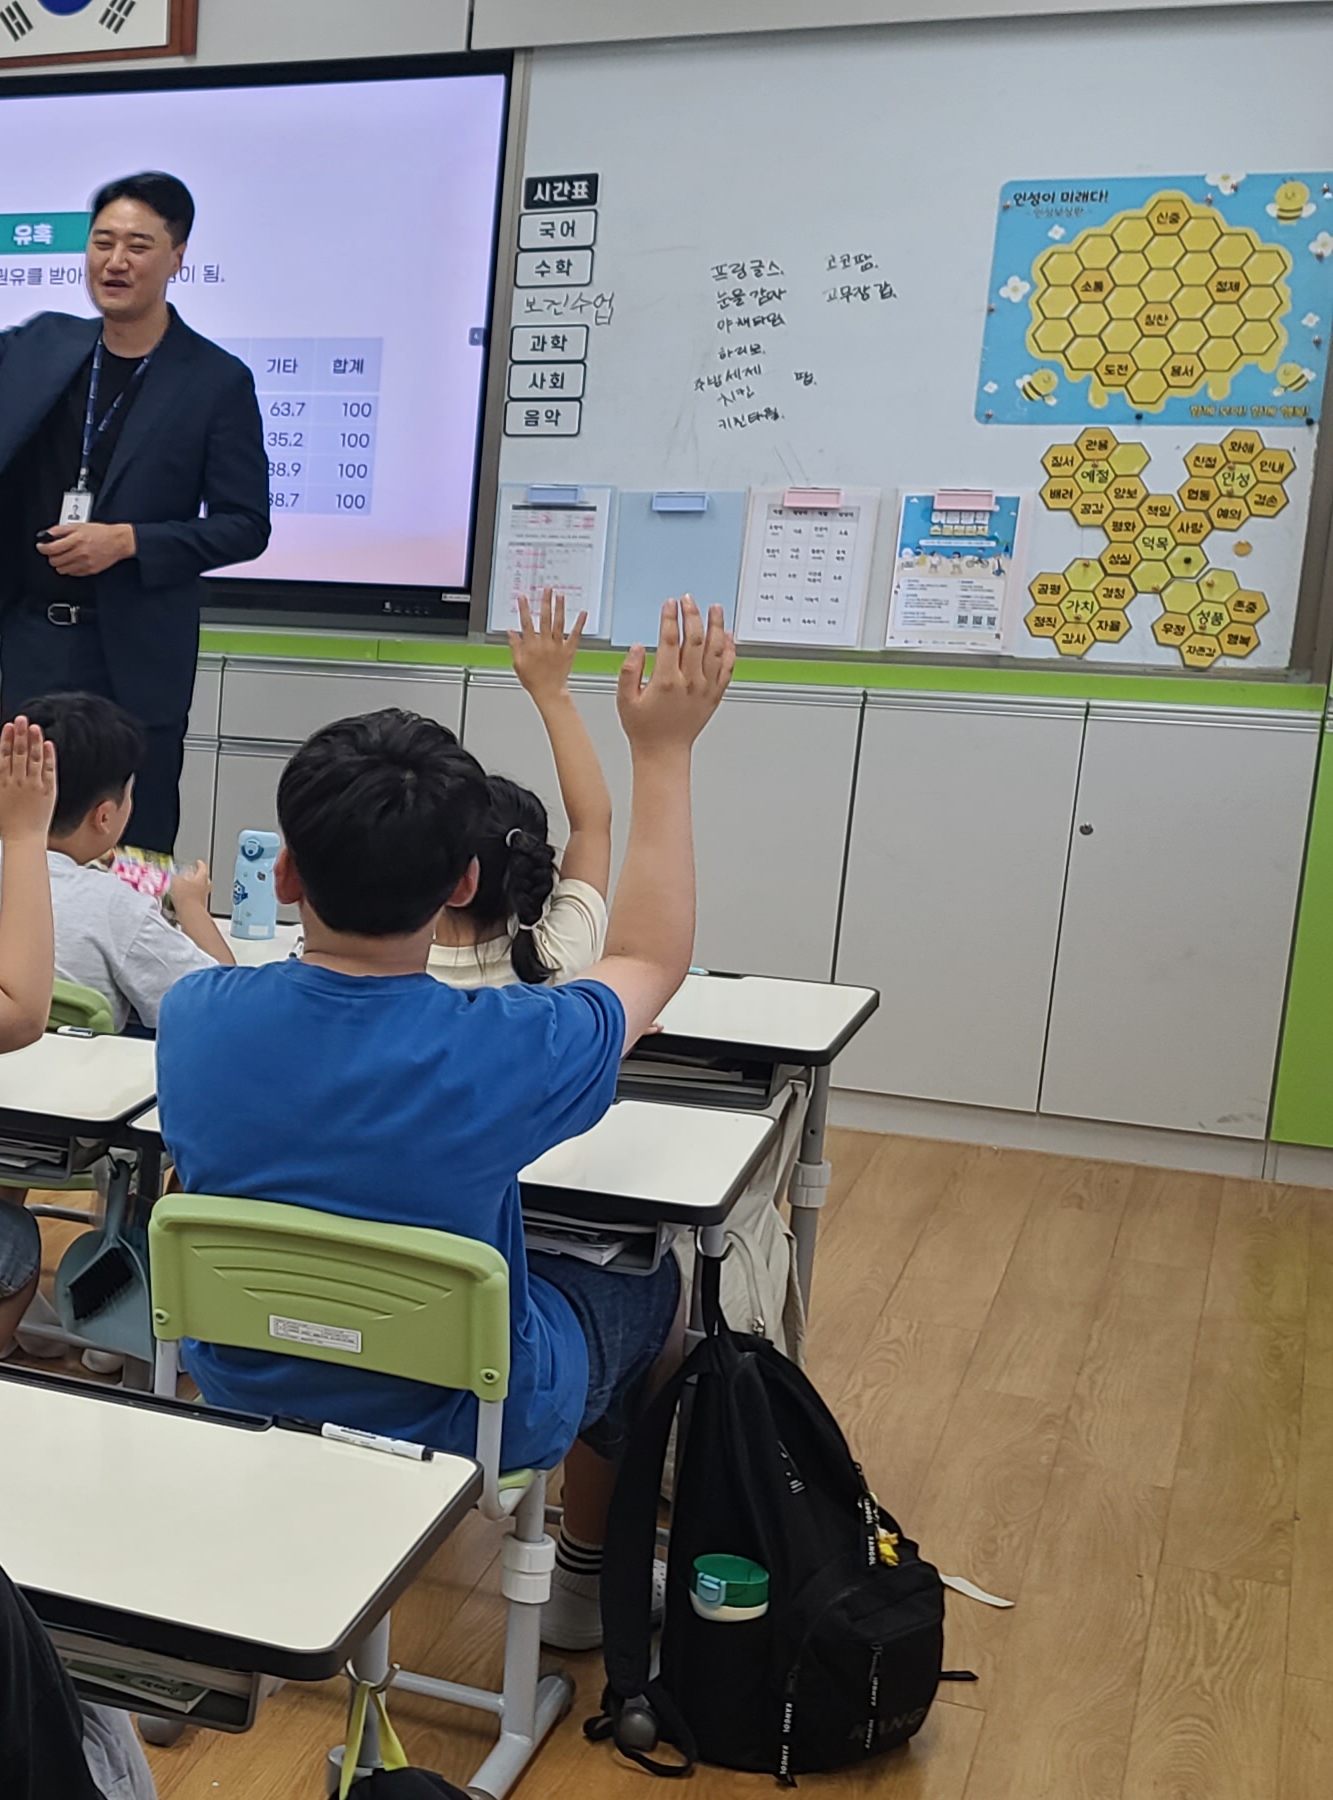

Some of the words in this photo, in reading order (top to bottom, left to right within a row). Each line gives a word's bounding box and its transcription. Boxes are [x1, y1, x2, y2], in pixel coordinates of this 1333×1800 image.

[533, 180, 589, 201] 시간표
[1014, 191, 1055, 207] 인성이
[1060, 190, 1109, 203] 미래다!
[12, 223, 53, 245] 유혹
[539, 219, 576, 239] 국어
[49, 265, 83, 286] 받아
[203, 263, 226, 284] 됨.
[534, 258, 573, 278] 수학
[529, 334, 568, 353] 과학
[266, 357, 299, 374] 기타
[332, 357, 364, 374] 합계
[1104, 363, 1129, 376] 도전
[528, 371, 565, 390] 사회
[269, 401, 306, 417] 63.7
[342, 402, 372, 417] 100
[523, 408, 562, 427] 음악
[267, 432, 303, 447] 35.2
[340, 433, 370, 448] 100
[1051, 455, 1074, 468] 질서
[1192, 455, 1217, 469] 친절
[1259, 460, 1284, 473] 인내
[338, 463, 368, 478] 100
[1081, 467, 1109, 484] 예절
[1221, 469, 1250, 487] 인성
[1049, 488, 1073, 500] 배려
[1113, 487, 1138, 499] 양보
[336, 494, 366, 509] 100
[1080, 503, 1104, 515] 공감
[1146, 505, 1171, 518] 책임
[1216, 507, 1242, 520] 예의
[1111, 520, 1136, 533] 평화
[1177, 521, 1204, 534] 사랑
[1142, 536, 1169, 551] 덕목
[1108, 554, 1131, 566] 성실
[1037, 583, 1061, 595] 공평
[1102, 586, 1126, 600] 경청
[1065, 599, 1094, 615] 가치
[1033, 616, 1057, 628] 정직
[1096, 619, 1121, 631] 자율
[1196, 609, 1224, 627] 성품
[1161, 621, 1186, 635] 우정
[1061, 632, 1087, 645] 감사
[1185, 644, 1217, 657] 자존감
[782, 1702, 793, 1733] KANGOL
[779, 1744, 790, 1775] KANGOL
